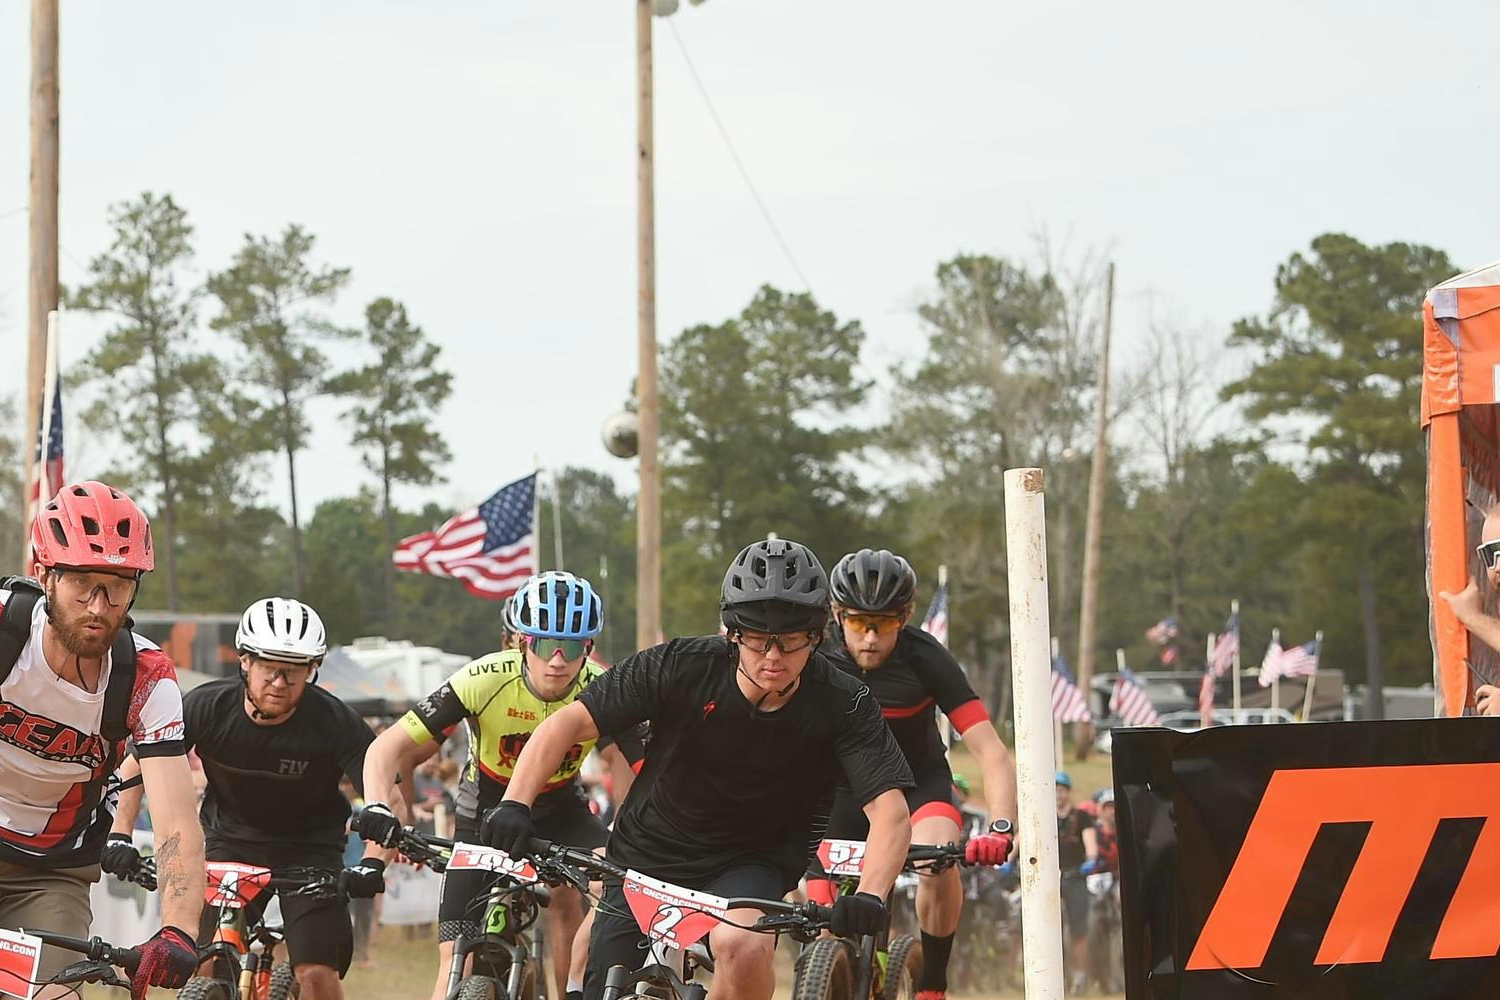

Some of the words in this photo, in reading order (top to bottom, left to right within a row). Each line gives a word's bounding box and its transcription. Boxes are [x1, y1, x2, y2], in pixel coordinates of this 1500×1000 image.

[468, 662, 499, 677] LIVE
[502, 660, 515, 673] IT
[279, 759, 308, 775] FLY
[652, 903, 683, 939] 2
